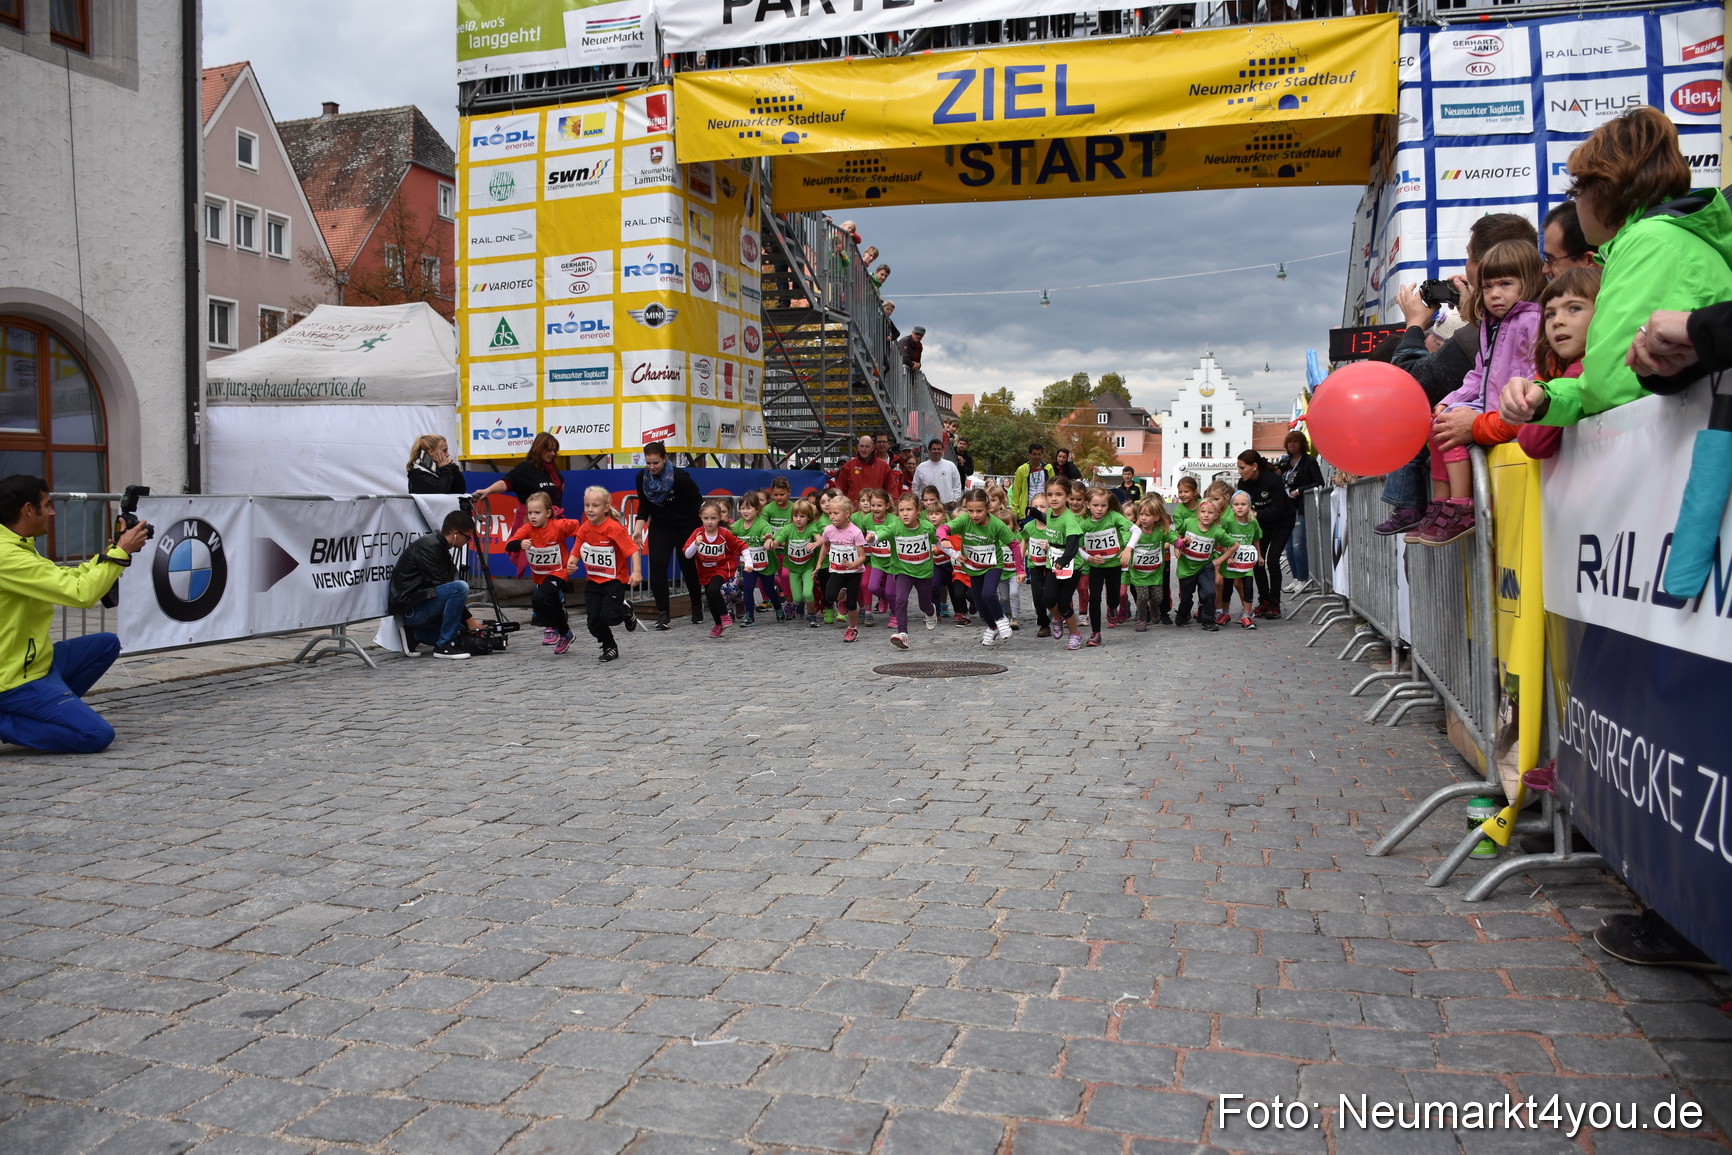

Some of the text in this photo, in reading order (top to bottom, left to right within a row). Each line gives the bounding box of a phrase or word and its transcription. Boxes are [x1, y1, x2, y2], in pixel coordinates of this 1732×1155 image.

[481, 17, 505, 29] wo's
[469, 26, 541, 49] langgeht!
[581, 31, 644, 46] NeuerMarkt
[1453, 38, 1494, 47] GERHART
[1472, 44, 1500, 52] JANIG
[1545, 45, 1613, 59] RAIL.ONE
[1694, 40, 1718, 54] DEHN
[1471, 65, 1491, 73] KIA
[1188, 70, 1357, 97] Neumarkter Stadtlauf
[933, 64, 1095, 125] ZIEL
[1444, 104, 1521, 116] Neumarkter Tagblatt
[1551, 95, 1641, 116] NATHUS
[707, 109, 847, 131] Neumarkter Stadtlauf
[958, 134, 1166, 187] START
[1204, 147, 1342, 165] Neumarkter Stadtlauf
[1684, 153, 1719, 168] wn
[548, 168, 590, 184] swn
[802, 171, 922, 188] Neumarkter Stadtlauf
[1464, 166, 1531, 180] VARIOTEC
[575, 179, 600, 188] neumarkt
[624, 216, 672, 227] RAIL.ONE
[471, 234, 516, 245] RAIL.ONE
[561, 261, 590, 269] GERHART
[488, 279, 533, 292] VARIOTEC
[645, 311, 664, 319] MINI
[552, 370, 606, 380] Neumarkter Tagblatt
[472, 382, 518, 392] RAIL.ONE
[564, 423, 611, 434] VARIOTEC
[699, 542, 723, 555] 7004
[899, 541, 927, 554] 7224
[1087, 536, 1116, 549] 7215
[1191, 541, 1211, 553] 219
[310, 535, 359, 564] BMW
[753, 551, 765, 561] 40
[529, 552, 558, 564] 7227
[583, 551, 612, 567] 7185
[831, 552, 855, 563] 7181
[967, 549, 993, 564] 7077
[1136, 553, 1160, 565] 7225
[312, 569, 364, 589] WENIGER
[1588, 709, 1685, 833] STRECKE
